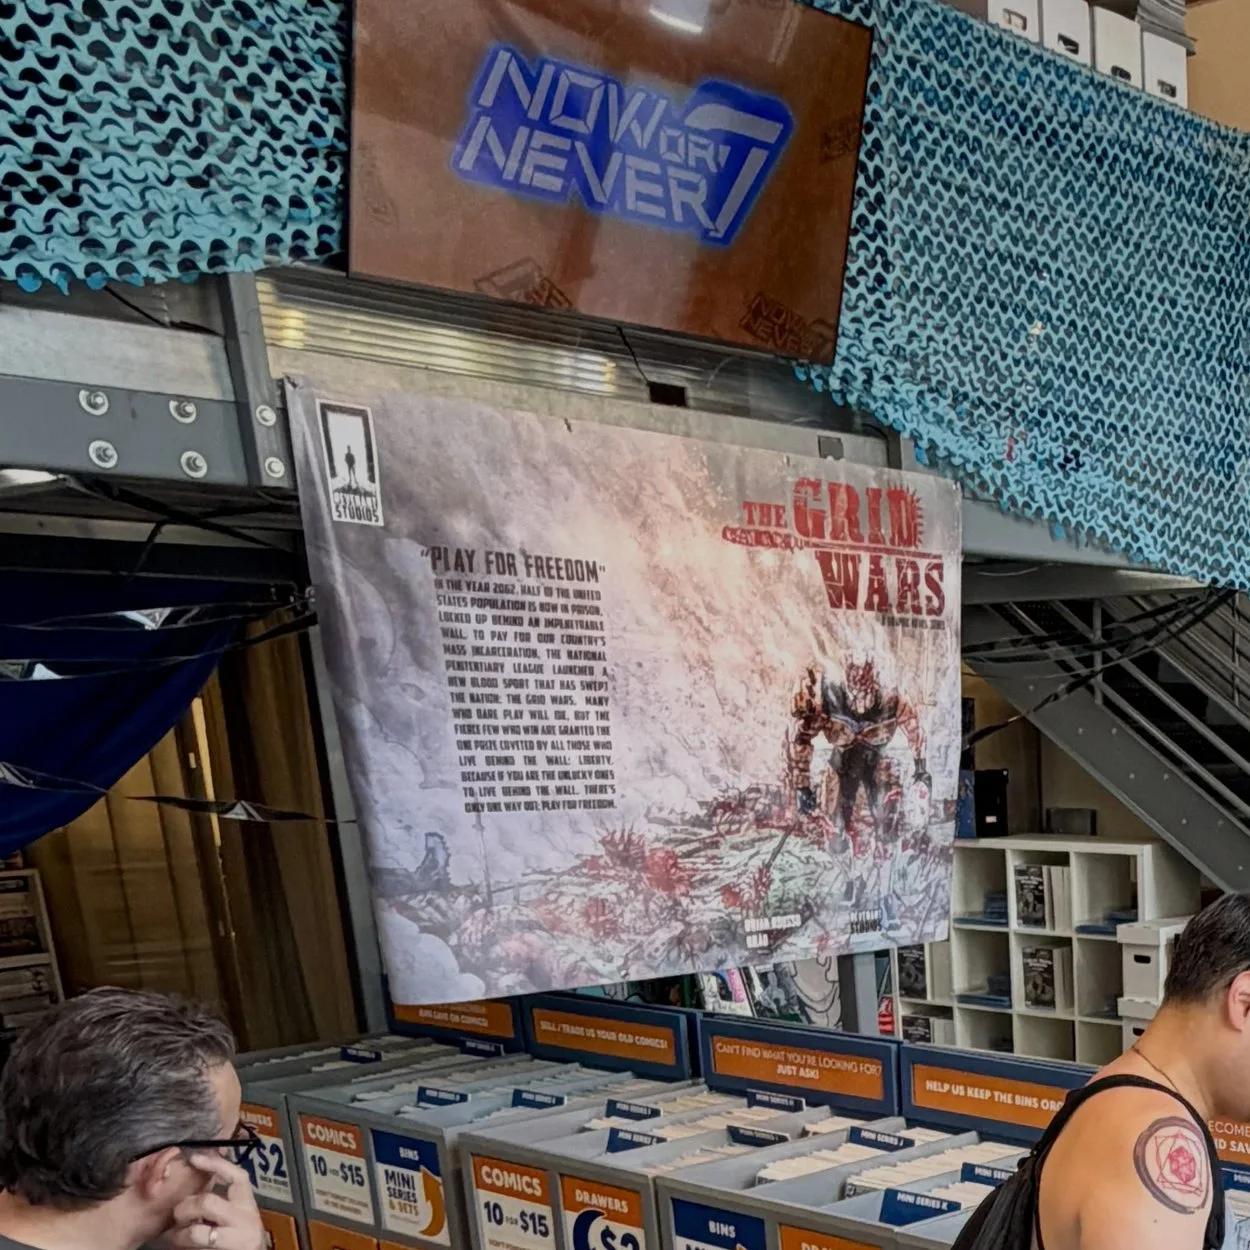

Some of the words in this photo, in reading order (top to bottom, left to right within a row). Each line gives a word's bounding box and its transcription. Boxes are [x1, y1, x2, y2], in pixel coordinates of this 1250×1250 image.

[478, 50, 668, 148] NOW
[660, 126, 719, 172] OR
[459, 115, 718, 232] NEVER
[685, 103, 783, 238] 7
[335, 503, 379, 522] STUDIOS
[742, 501, 788, 528] THE
[794, 477, 923, 548] GRID
[485, 551, 518, 576] FOR
[815, 550, 945, 616] WARS
[540, 1020, 557, 1031] SELL
[561, 1022, 584, 1036] TRADE
[585, 1028, 595, 1038] US
[597, 1029, 616, 1042] YOUR
[618, 1032, 633, 1044] OLD
[740, 1045, 761, 1059] FIND
[762, 1048, 785, 1062] WHAT
[787, 1051, 817, 1066] YOU'RE
[819, 1058, 858, 1073] LOOKING
[860, 1062, 882, 1076] FOR?
[776, 1065, 797, 1077] JUST
[926, 1080, 949, 1093] HELP
[952, 1084, 965, 1095] US
[967, 1085, 991, 1100] KEEP
[993, 1089, 1013, 1103] THE
[1015, 1094, 1039, 1109] BINS
[307, 1122, 357, 1150] COMICS
[860, 1130, 875, 1140] MINI
[877, 1132, 898, 1144] SERIES
[1209, 1120, 1250, 1138] ECOME
[311, 1154, 327, 1177] 10
[340, 1161, 364, 1187] $15
[384, 1169, 416, 1191] MINI
[480, 1165, 542, 1197] COMICS
[386, 1187, 417, 1203] SERIES
[575, 1189, 628, 1213] DRAWERS
[898, 1191, 915, 1203] MINI
[916, 1195, 940, 1208] SERIES
[484, 1201, 504, 1226] 10
[505, 1215, 518, 1225] FOR
[519, 1209, 549, 1238] $15
[708, 1219, 736, 1239] BINS
